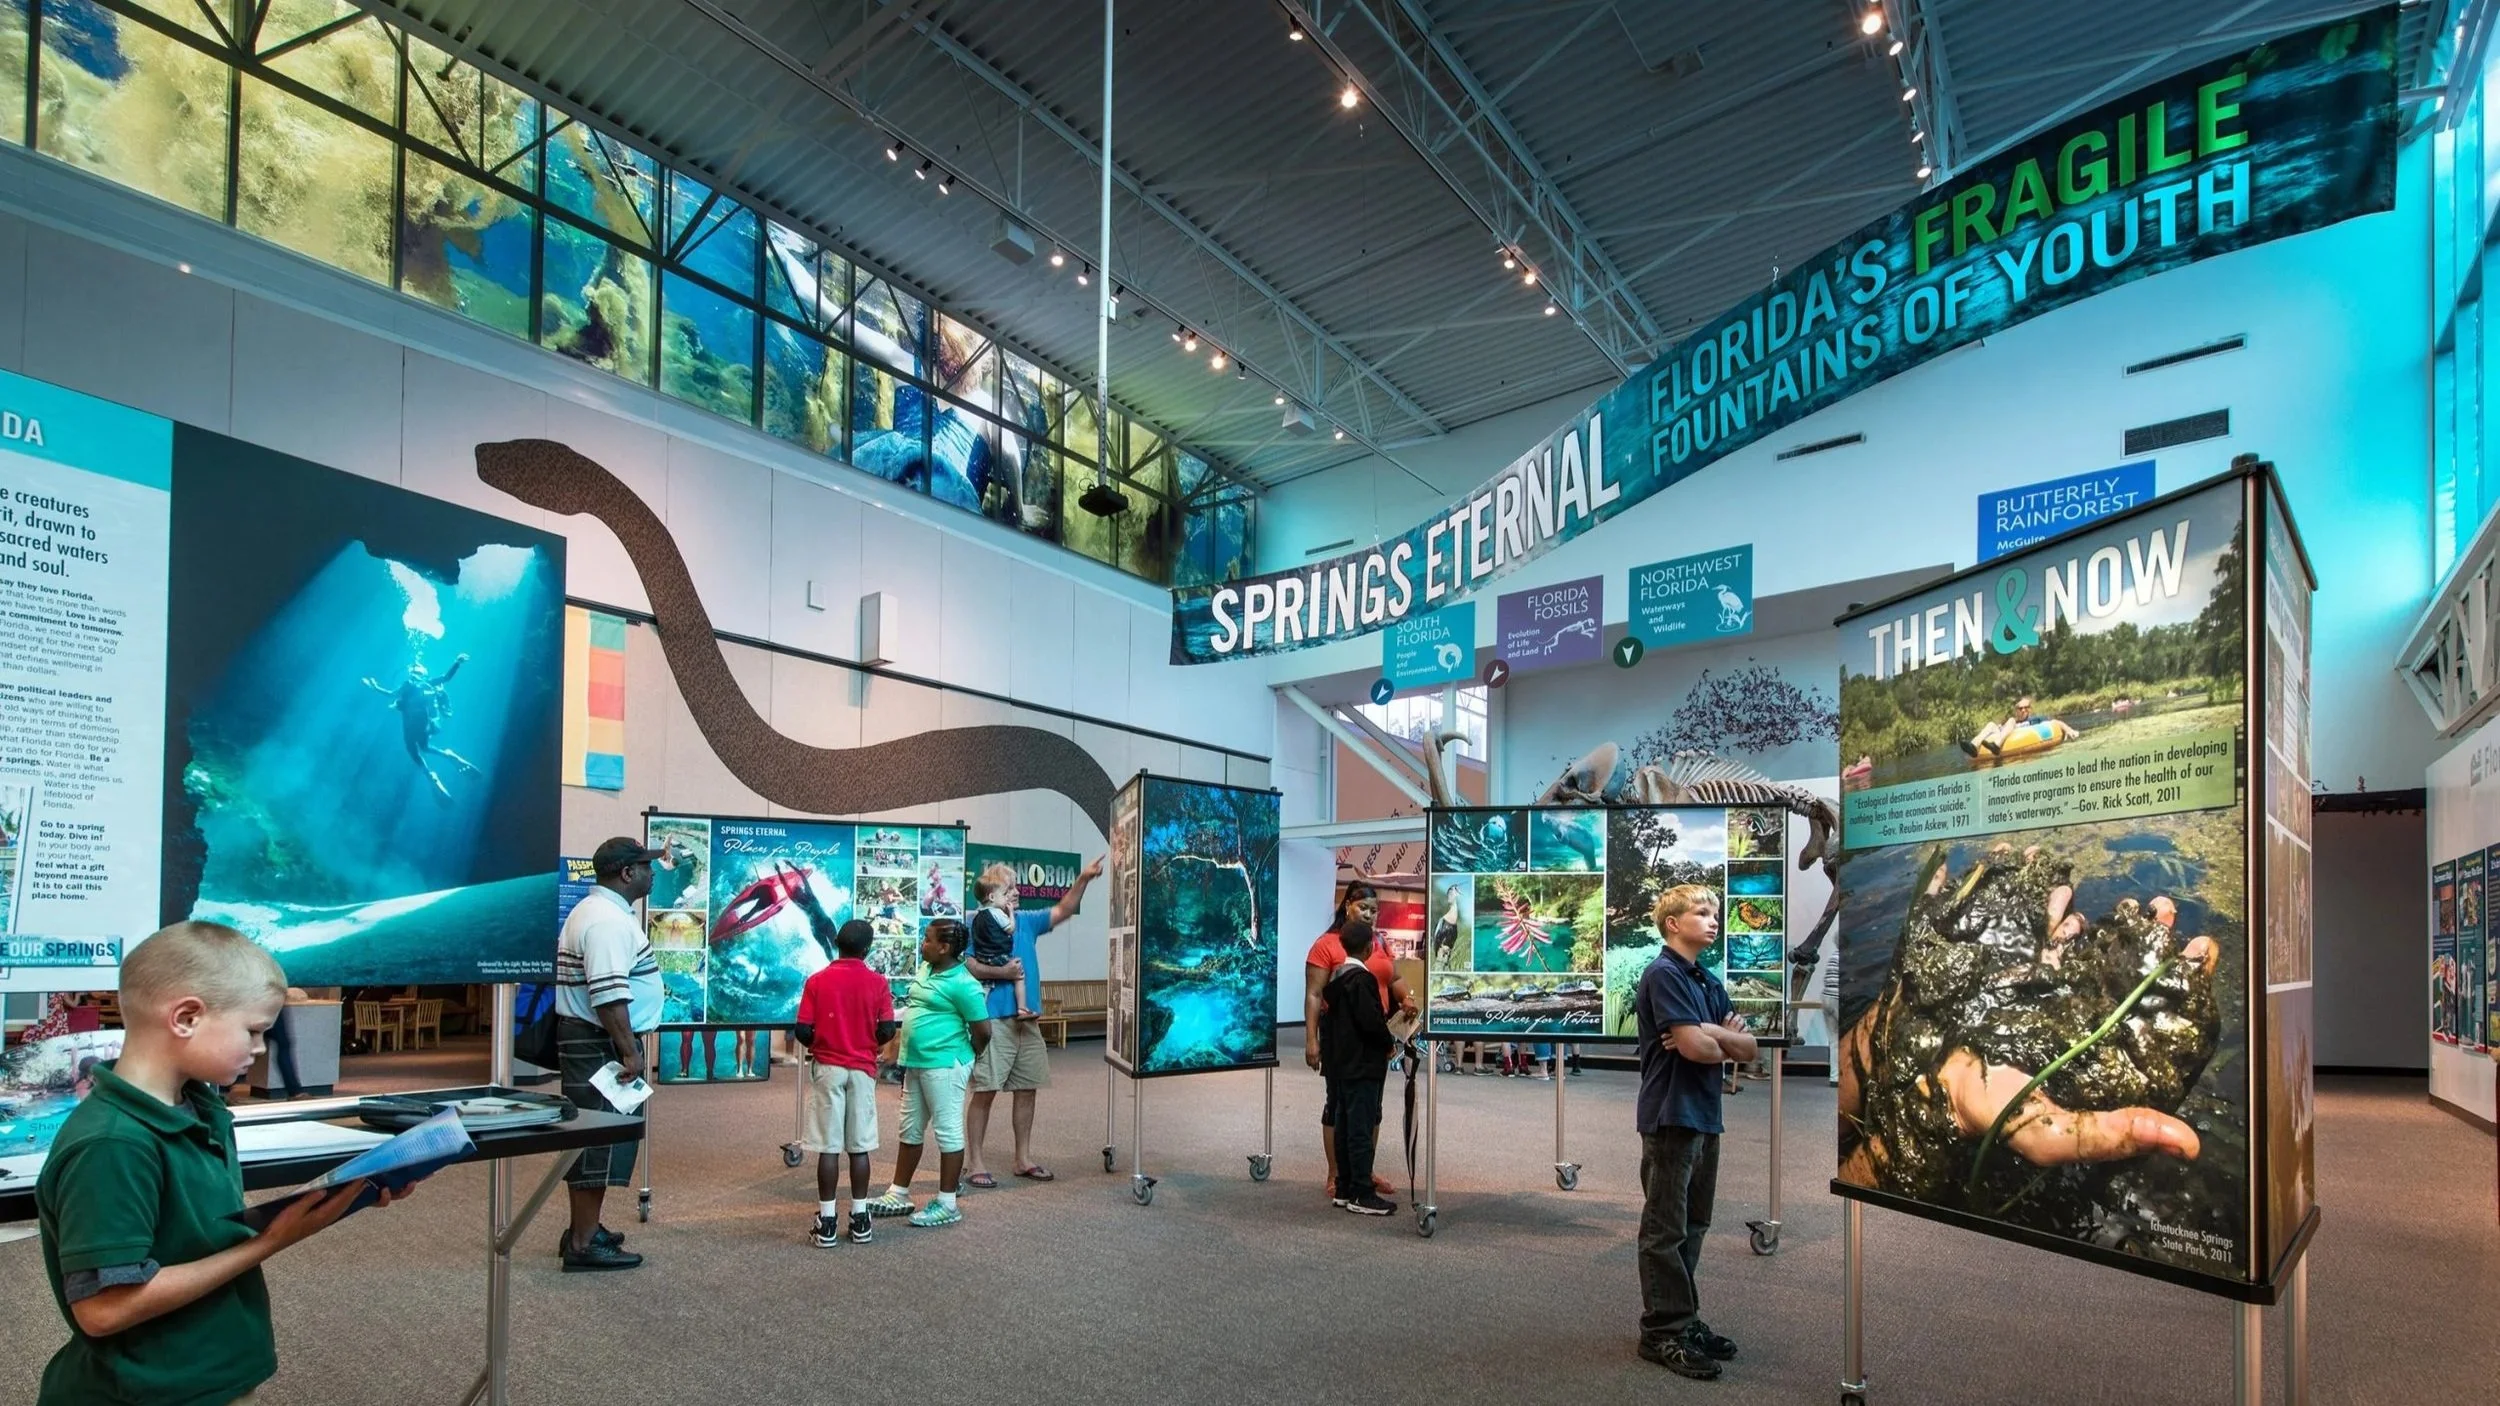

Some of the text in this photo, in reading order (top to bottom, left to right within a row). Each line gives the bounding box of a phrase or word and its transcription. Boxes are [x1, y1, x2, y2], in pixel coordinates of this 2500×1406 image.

[1652, 72, 2248, 424] FLORIDA'S FRAGILE
[1652, 160, 2250, 477] FOUNTAINS OF YOUTH
[15, 491, 89, 518] creatures
[1997, 476, 2120, 515] BUTTERFLY
[1996, 491, 2139, 533] RAINFOREST
[25, 510, 75, 536] drawn
[81, 525, 96, 541] to
[1211, 413, 1621, 653] SPRINGS ETERNAL
[0, 531, 108, 564] sacred waters
[1997, 534, 2046, 550] McGuire
[32, 559, 70, 577] soul.
[1641, 554, 1742, 586] NORTHWEST
[17, 580, 38, 592] they
[40, 585, 59, 595] love
[1527, 586, 1589, 608] FLORIDA
[1641, 577, 1709, 601] FLORIDA
[1641, 601, 1686, 615] Waterways
[1868, 591, 1983, 681] THEN
[1991, 568, 2039, 655] &
[2044, 519, 2190, 632] NOW
[66, 609, 117, 626] Love is also
[1535, 599, 1589, 621] FOSSILS
[1648, 614, 1663, 625] and
[8, 611, 67, 627] commitment
[69, 619, 79, 629] to
[81, 623, 124, 637] tomorrow.
[1396, 615, 1440, 634] SOUTH
[1653, 621, 1686, 634] Wildlife
[1396, 626, 1451, 647] FLORIDA
[1508, 628, 1540, 640] Evolution
[1507, 639, 1530, 649] of Life
[1507, 647, 1539, 659] and Land
[1396, 650, 1417, 660] People
[1396, 660, 1408, 669] and
[1396, 664, 1438, 678] Environments
[17, 685, 56, 697] political
[58, 690, 93, 701] leaders
[95, 695, 112, 704] and
[28, 696, 47, 705] who
[66, 701, 93, 713] willing
[95, 705, 104, 713] to
[46, 760, 71, 768] Water
[74, 762, 81, 770] is
[83, 763, 104, 772] what
[89, 754, 102, 763] Be
[2023, 768, 2063, 783] continues
[2066, 766, 2075, 777] to
[2077, 758, 2097, 775] lead
[2100, 757, 2115, 771] the
[2119, 753, 2151, 769] nation
[2154, 750, 2164, 763] in
[2167, 740, 2227, 761] developing
[1890, 789, 1927, 805] destruction
[1928, 787, 1936, 799] in
[1937, 781, 1963, 796] Florida
[1964, 781, 1971, 792] is
[1988, 763, 2215, 806] innovative programs to ensure the health of our
[2102, 793, 2122, 809] Rick
[2126, 791, 2153, 807] Scott,
[2156, 786, 2181, 803] 2011
[1849, 813, 1873, 825] nothing
[1874, 812, 1887, 822] less
[1888, 808, 1903, 820] than
[1905, 803, 1937, 816] economic
[40, 820, 53, 828] Go
[56, 821, 65, 829] to
[77, 823, 105, 833] spring
[721, 825, 787, 837] SPRINGS ETERNAL
[1899, 822, 1922, 834] Reubin
[1924, 819, 1949, 831] Askew,
[1952, 814, 1970, 828] 1971
[39, 830, 103, 841] today. Dive in!
[723, 838, 840, 863] Places for People
[1363, 843, 1384, 873] RESO
[35, 861, 53, 869] feel
[56, 862, 78, 870] what
[89, 863, 105, 872] gift
[567, 859, 594, 871] PASSP
[32, 881, 40, 889] it
[54, 882, 63, 890] to
[85, 883, 102, 891] this
[34, 871, 109, 882] beyond measure
[31, 891, 88, 901] place home.
[1039, 886, 1070, 898] SNAK
[1433, 1017, 1457, 1025] SPRINGS
[1485, 1009, 1530, 1025] Places
[1525, 1014, 1554, 1033] for
[1558, 1010, 1605, 1026] Nature
[2150, 1219, 2233, 1249] Ichetucknee Springs
[2162, 1237, 2232, 1263] State Park, 2011
